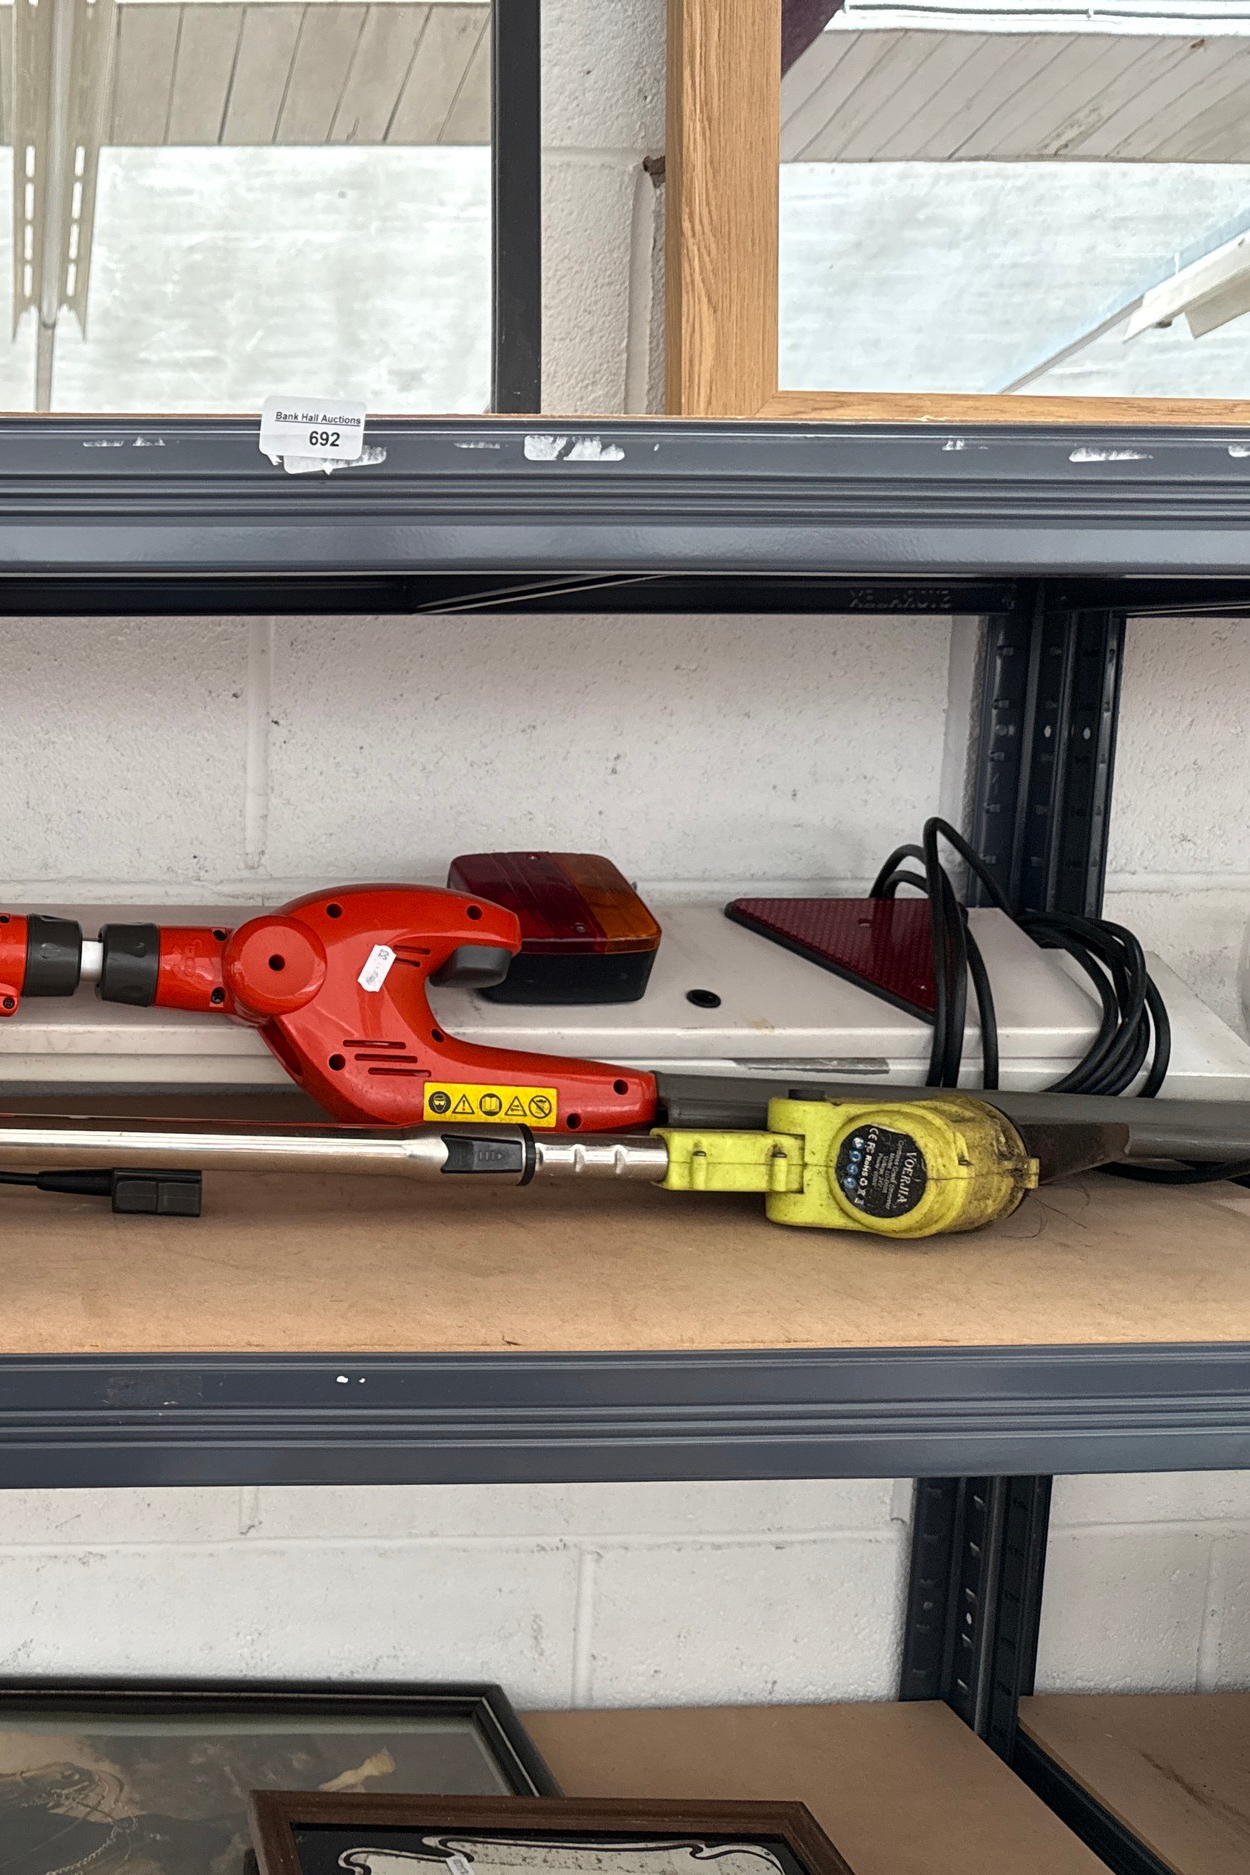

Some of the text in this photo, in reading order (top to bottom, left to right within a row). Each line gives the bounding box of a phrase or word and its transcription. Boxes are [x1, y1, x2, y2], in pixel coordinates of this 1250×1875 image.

[275, 411, 362, 425] Bank Hall Auctions
[309, 430, 341, 447] 692
[897, 1152, 917, 1202] VOERJIA
